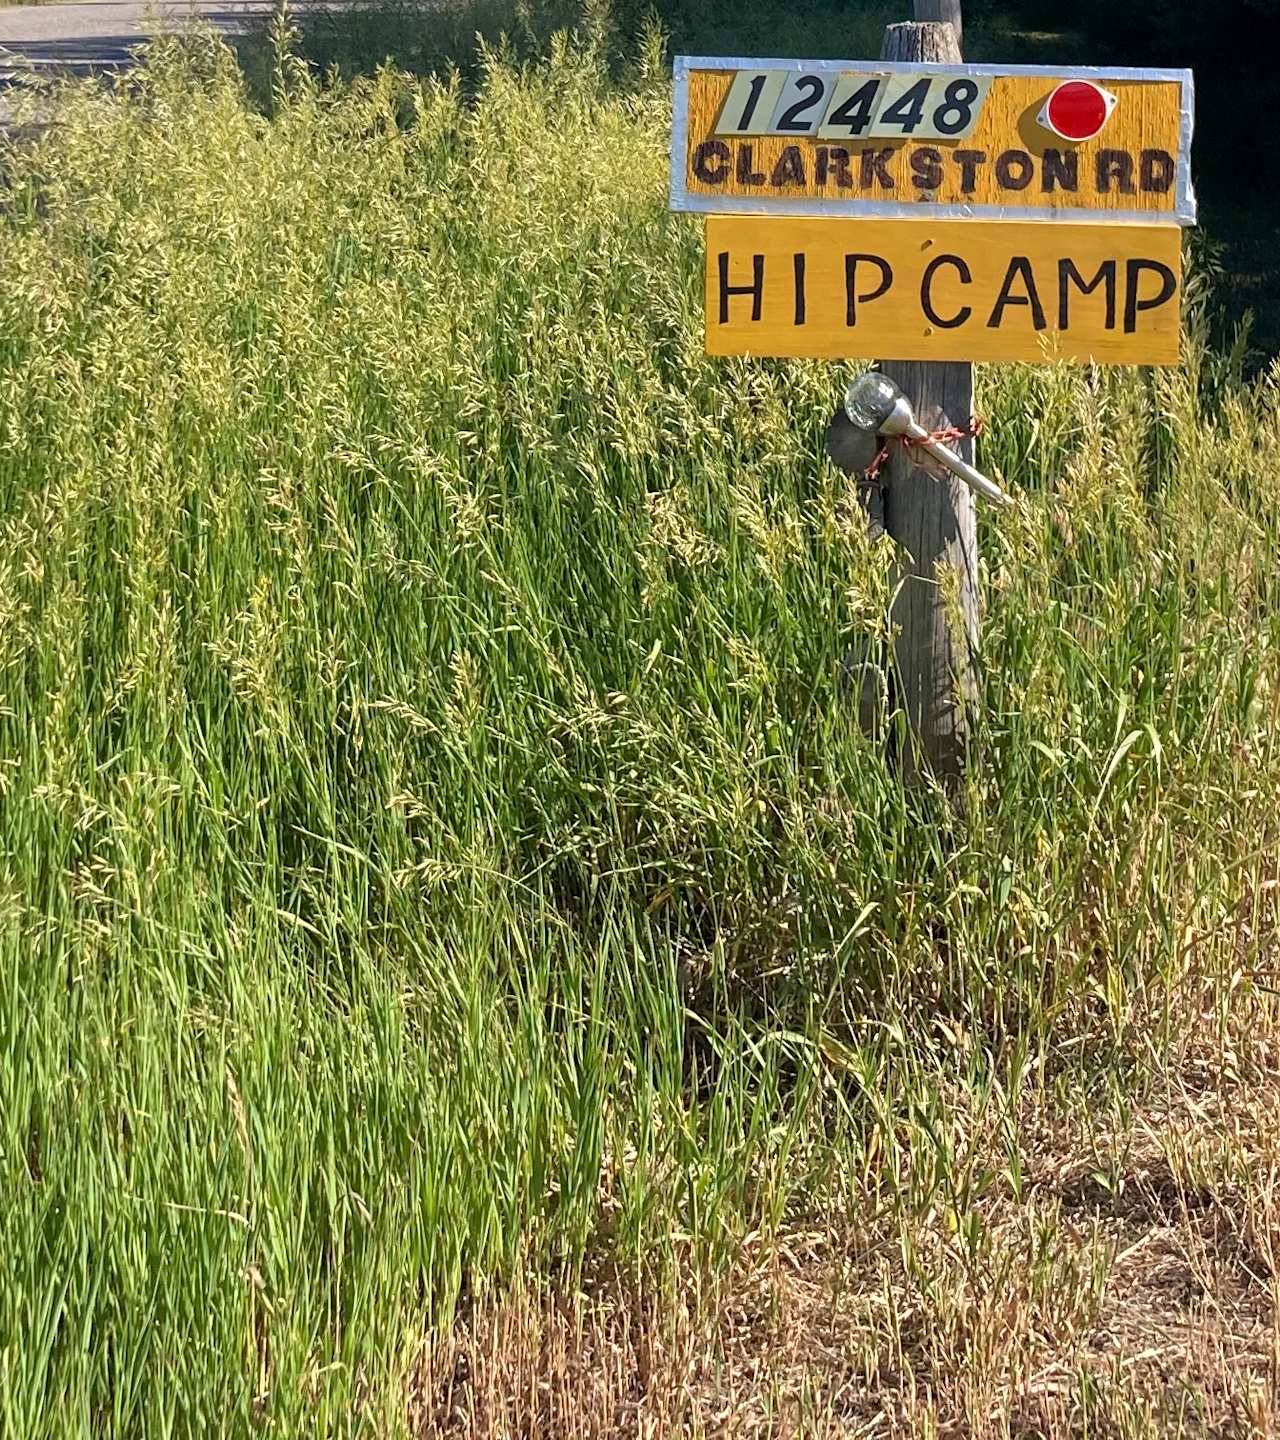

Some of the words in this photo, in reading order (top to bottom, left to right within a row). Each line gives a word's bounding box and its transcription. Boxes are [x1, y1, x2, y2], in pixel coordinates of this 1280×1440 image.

[736, 74, 979, 135] 12448
[691, 140, 1079, 194] CLARKSTON
[1095, 148, 1176, 194] RD
